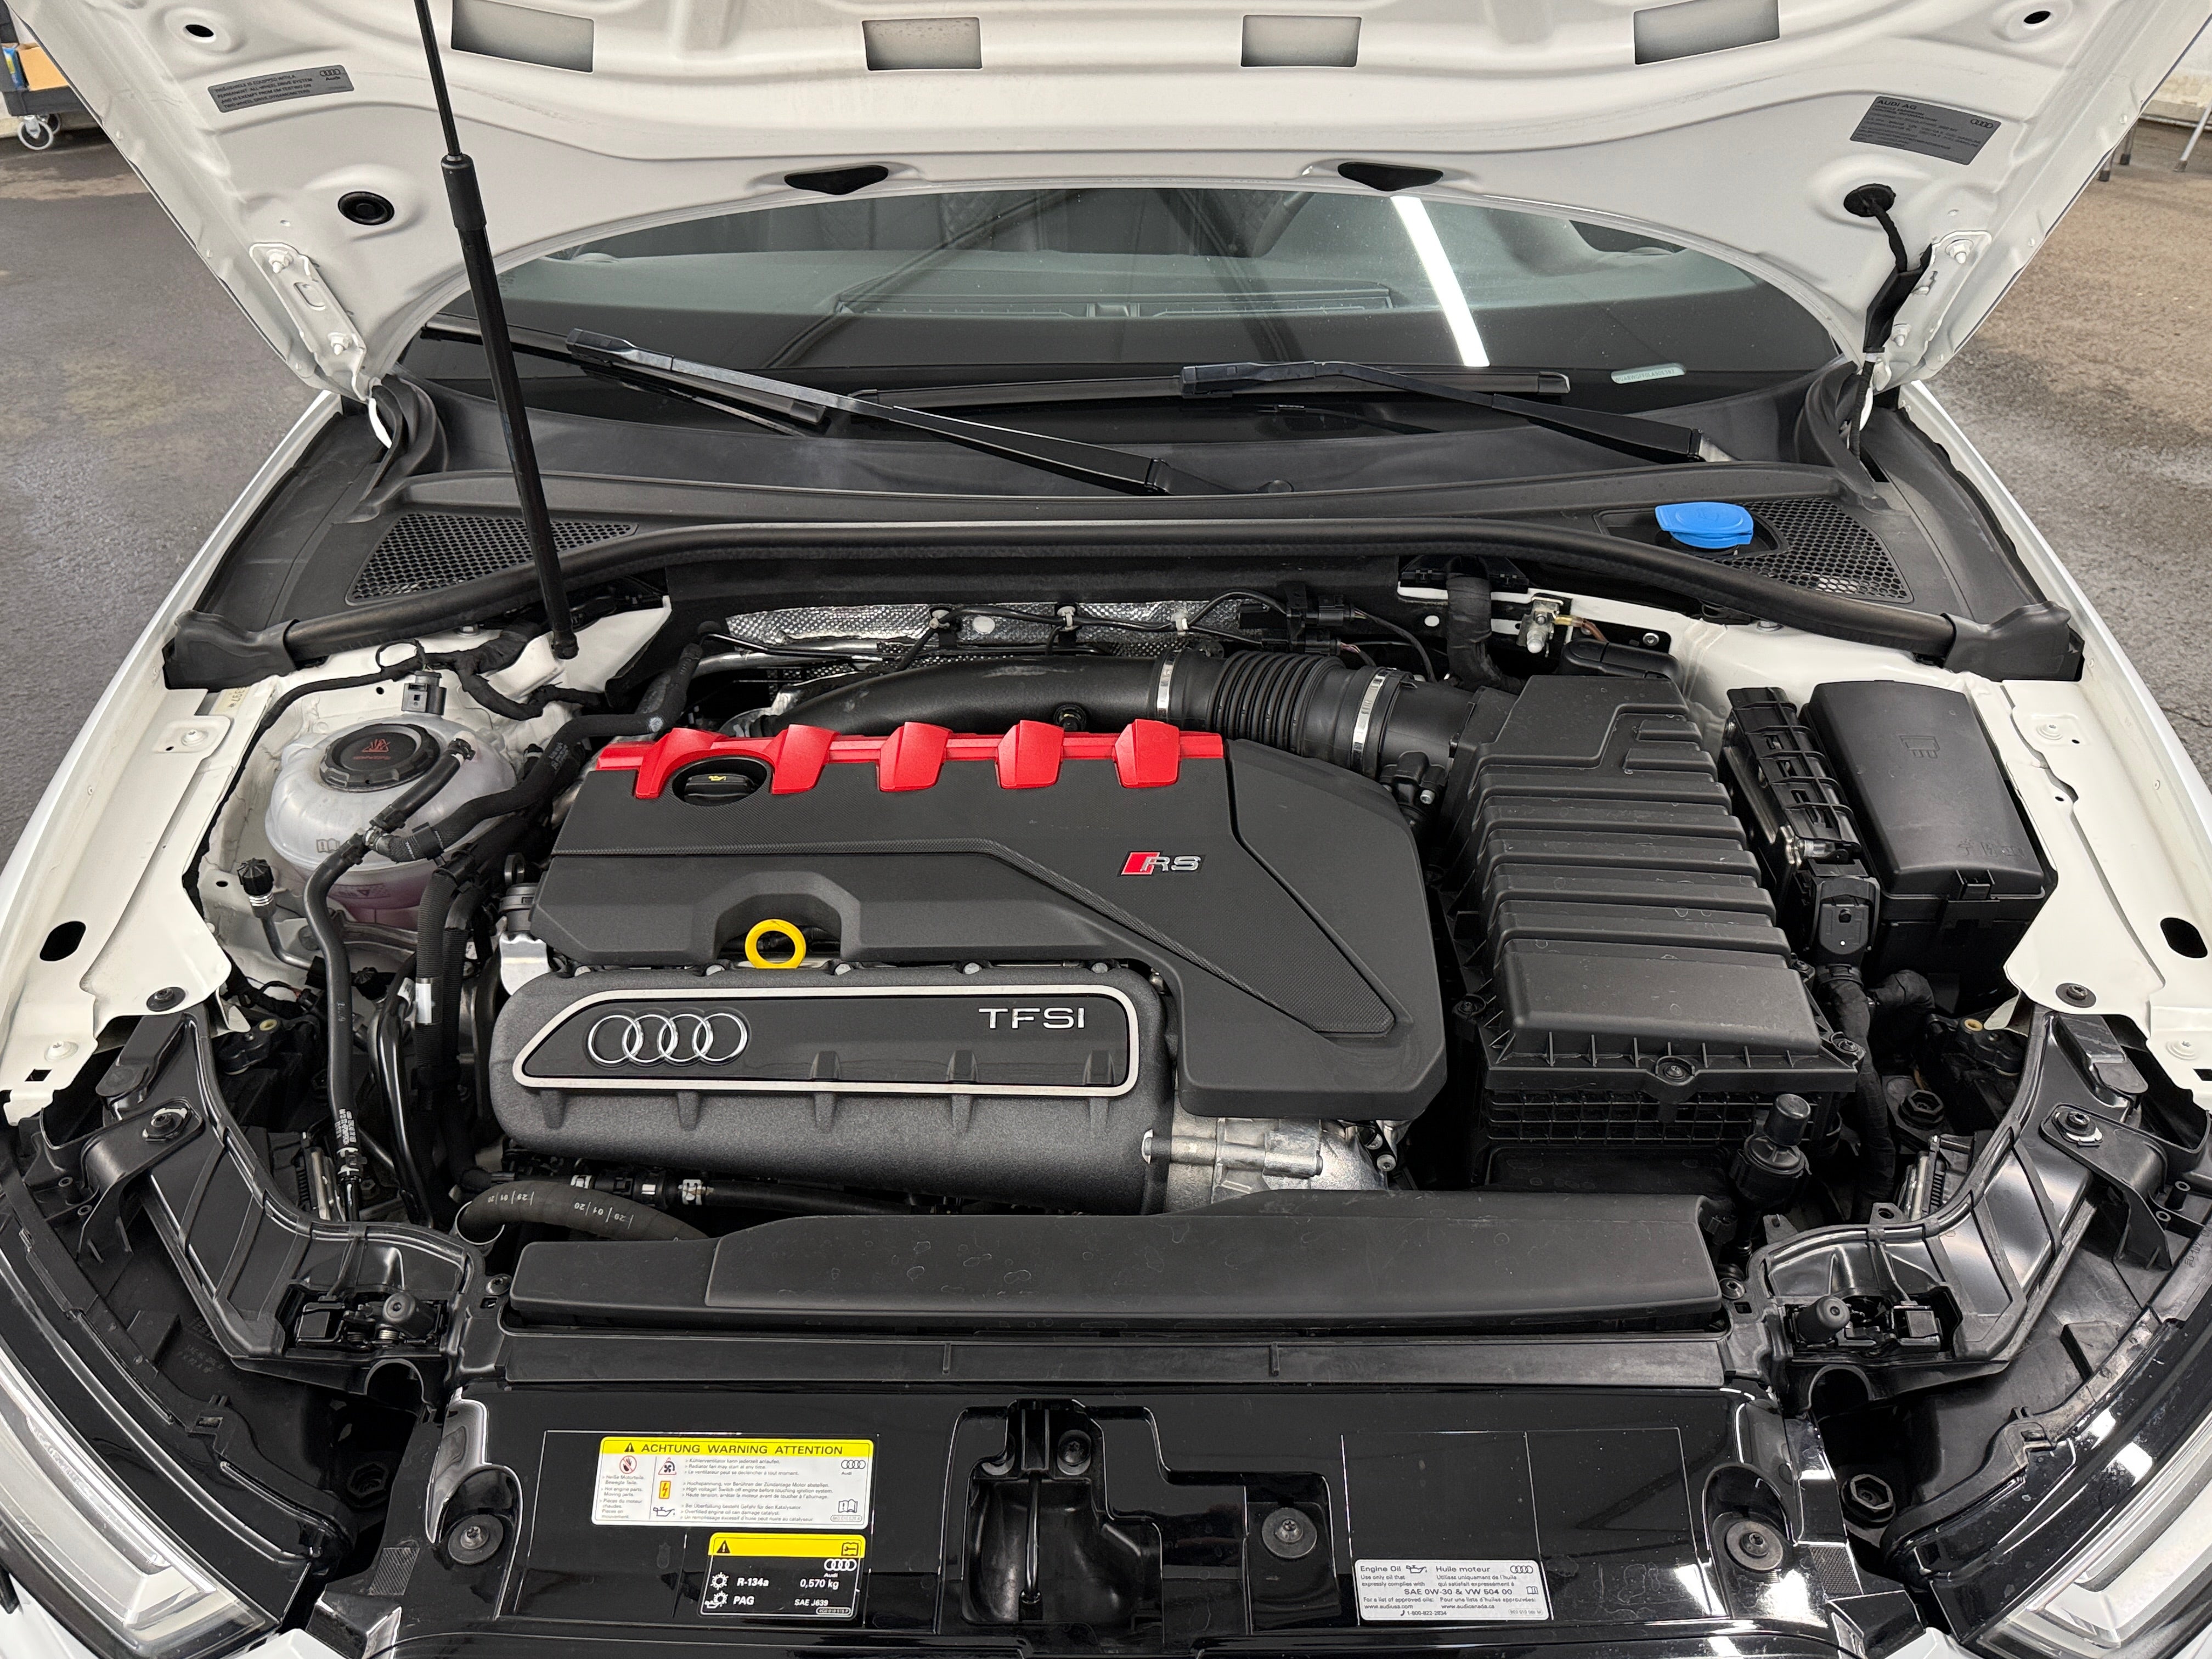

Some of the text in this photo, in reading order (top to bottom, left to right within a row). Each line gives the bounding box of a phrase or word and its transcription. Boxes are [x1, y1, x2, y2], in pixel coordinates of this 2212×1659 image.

[1140, 855, 1201, 872] RS
[978, 1007, 1085, 1029] TFSI
[641, 1444, 843, 1455] ACHTUNG WARNING ATTENTION
[737, 1578, 839, 1590] R-134a 0,570 kg
[733, 1596, 755, 1605] PAG
